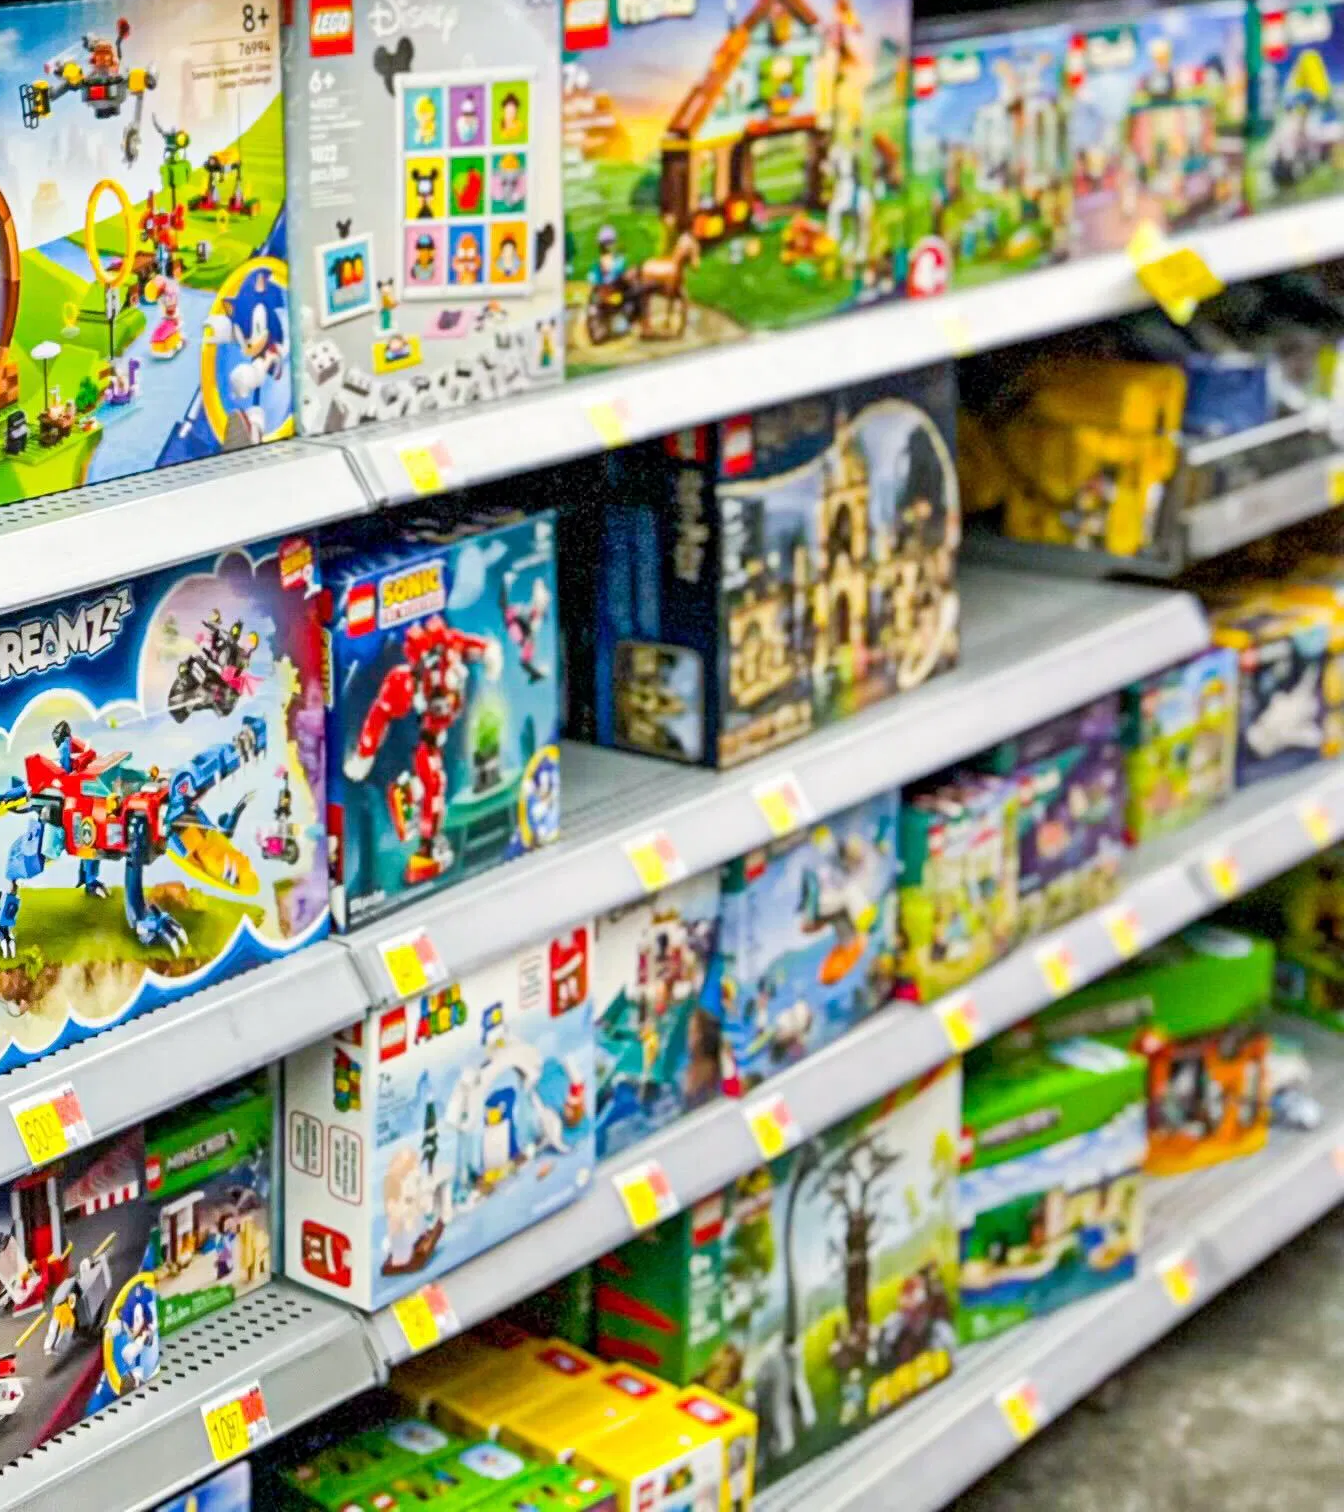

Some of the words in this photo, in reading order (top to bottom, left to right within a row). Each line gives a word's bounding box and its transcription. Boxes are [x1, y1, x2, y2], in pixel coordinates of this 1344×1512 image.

[242, 4, 270, 33] 8+
[315, 11, 352, 36] LEGO
[239, 40, 271, 55] 76994
[309, 70, 336, 93] 6+
[383, 568, 441, 607] SONIC
